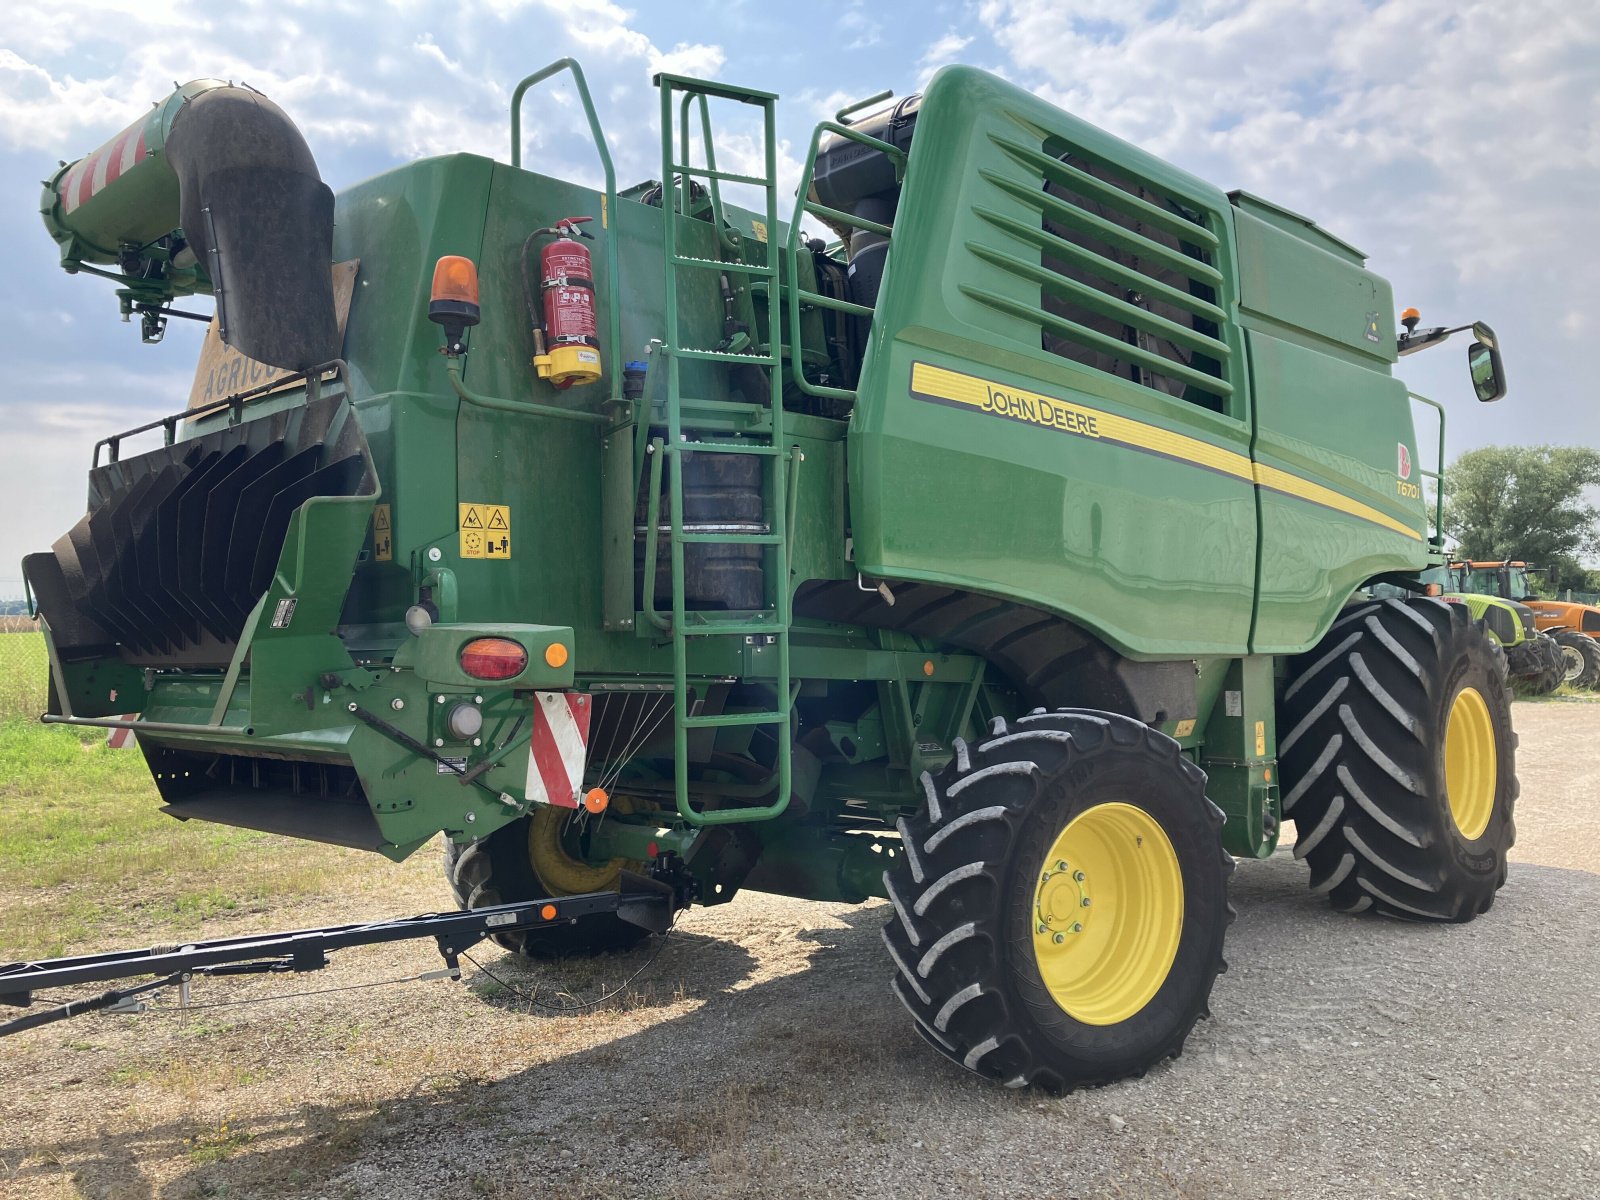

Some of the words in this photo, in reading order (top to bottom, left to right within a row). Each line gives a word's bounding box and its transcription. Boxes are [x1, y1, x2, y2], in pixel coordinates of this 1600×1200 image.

[982, 385, 1036, 420] JOHN
[1037, 398, 1099, 435] DEERE
[1396, 480, 1420, 499] T670i
